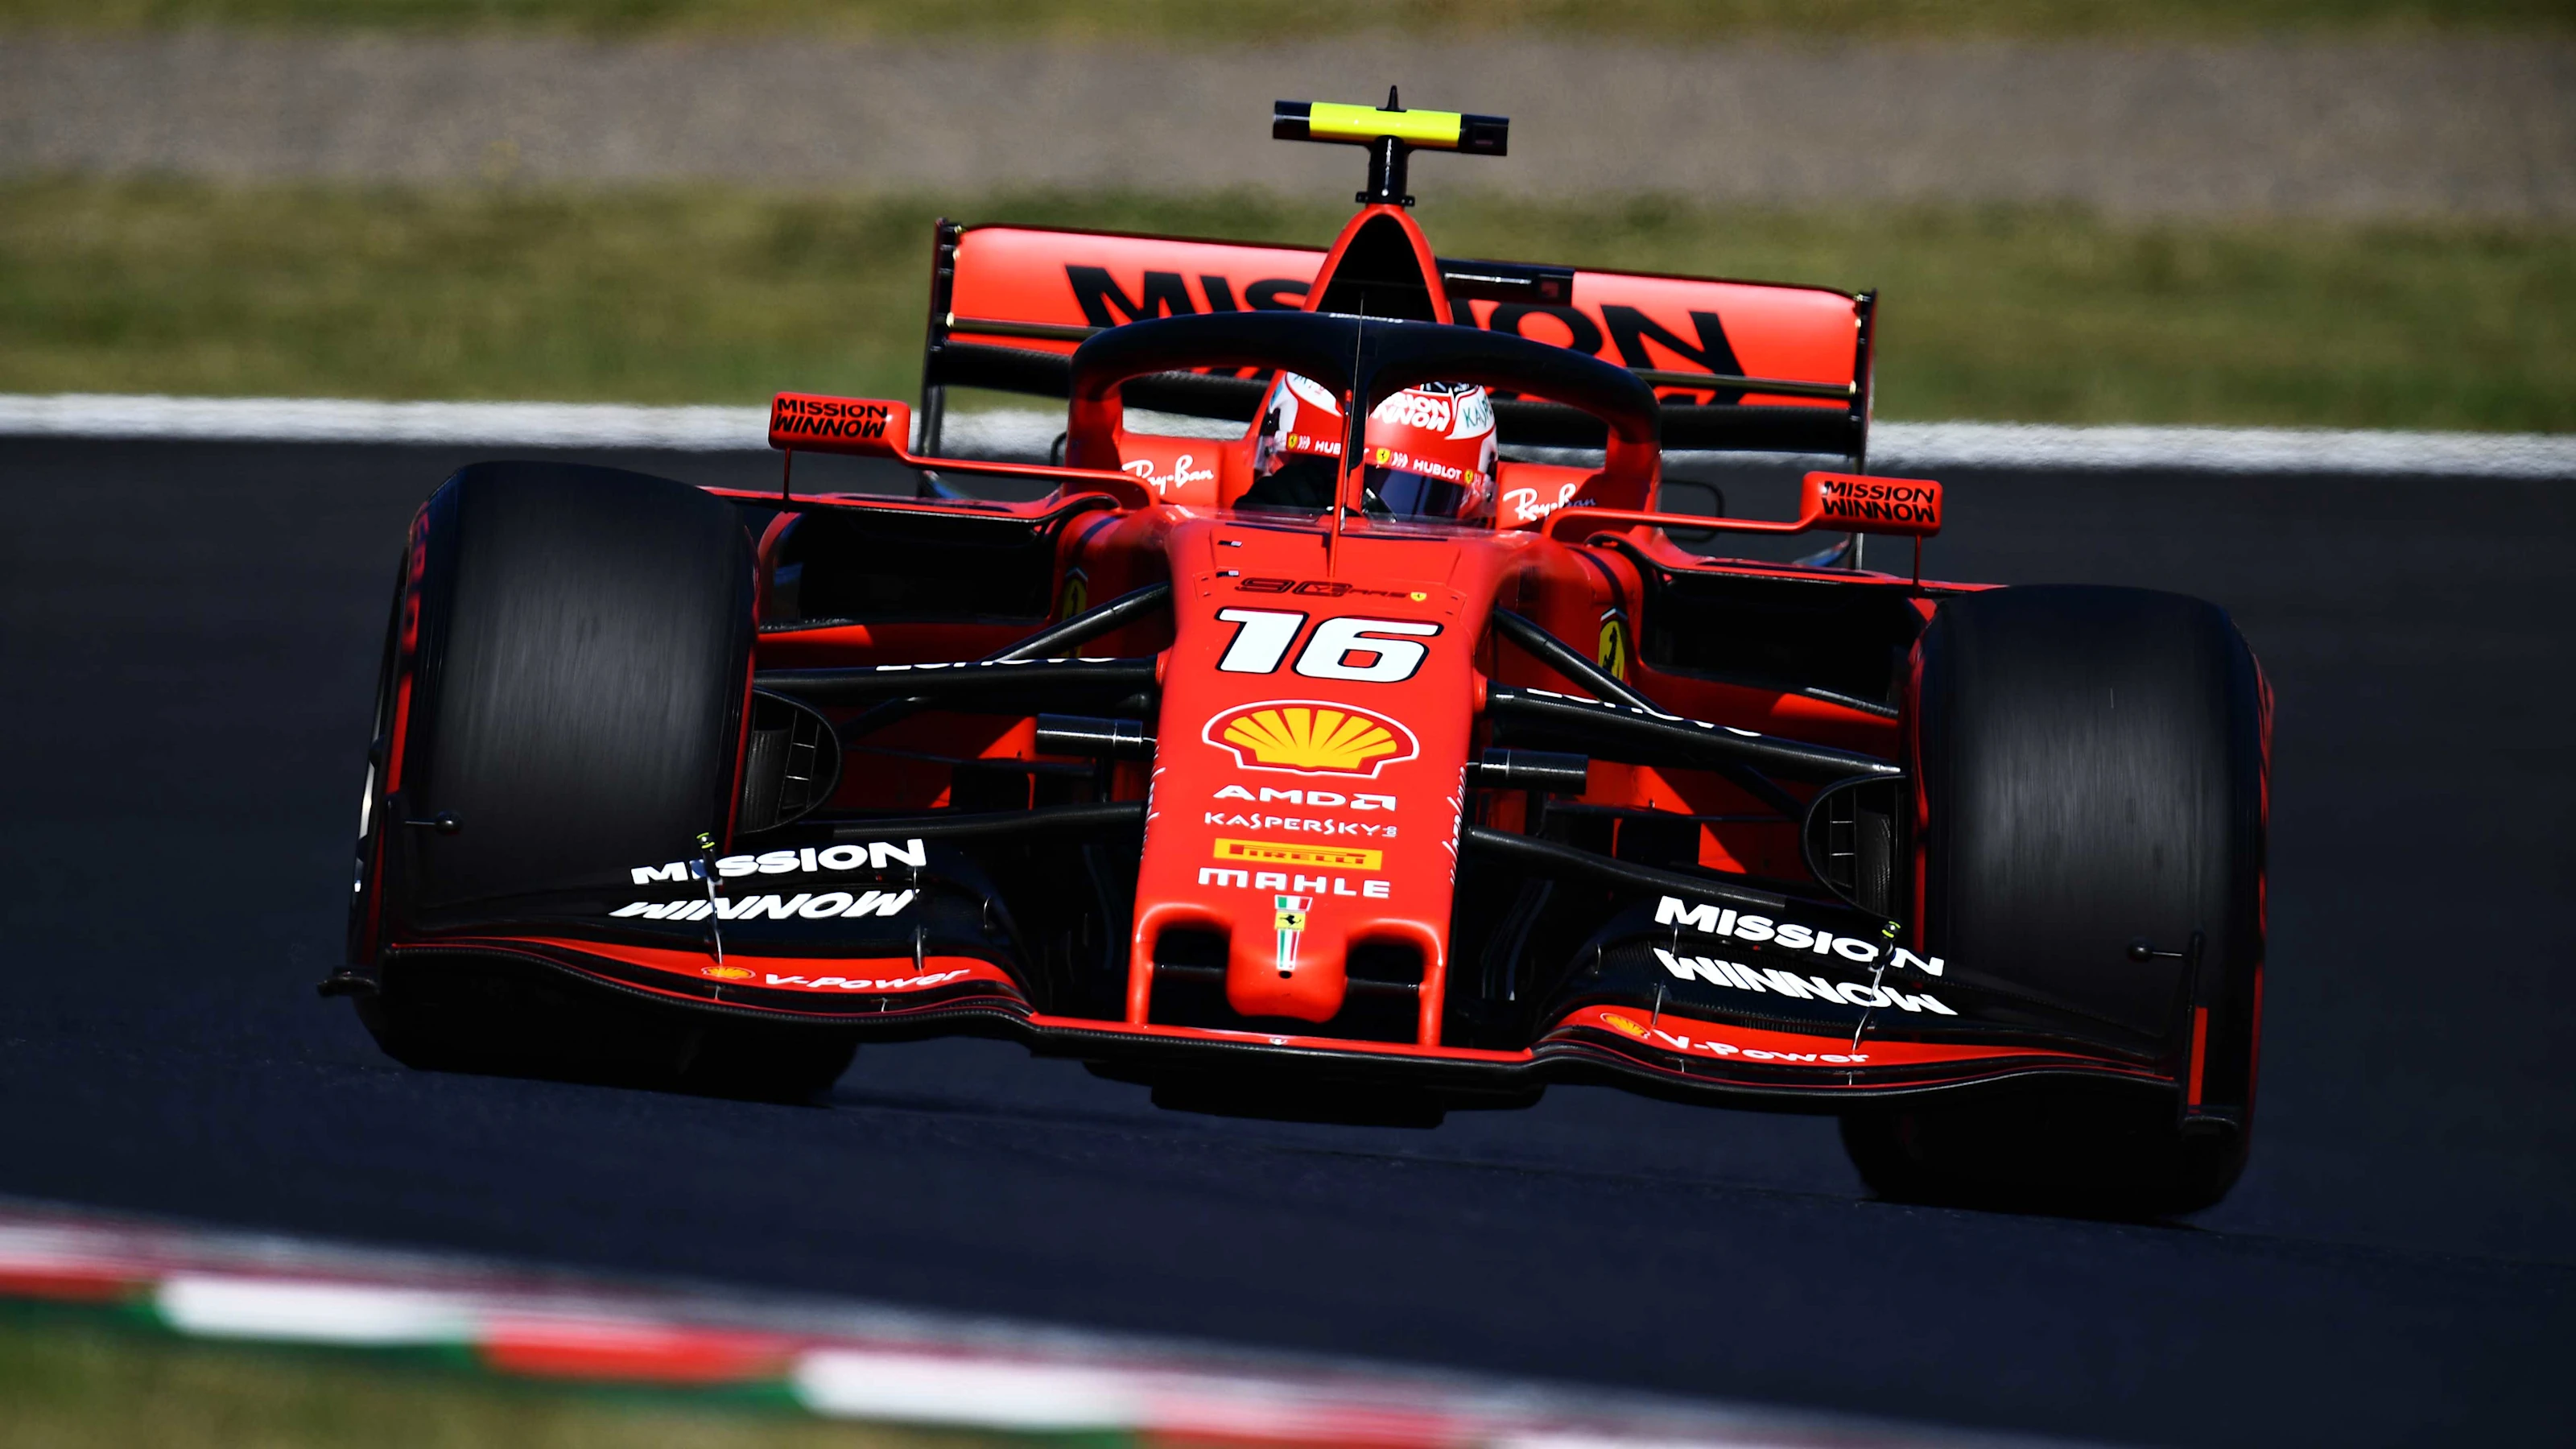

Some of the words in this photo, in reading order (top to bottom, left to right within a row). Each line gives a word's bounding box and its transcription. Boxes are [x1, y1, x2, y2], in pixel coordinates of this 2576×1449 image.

[777, 398, 888, 418] MISSION
[773, 413, 886, 439] WINNOW
[1121, 454, 1214, 496] Ray-Ban
[1413, 459, 1463, 481] HUBLOT
[1823, 481, 1934, 503] MISSION
[1822, 497, 1935, 522] WINNOW
[1213, 605, 1444, 683] 16
[1212, 784, 1347, 807] AMD
[1204, 811, 1381, 836] KASPERSKY
[1228, 843, 1368, 865] PIRELLI
[1197, 867, 1391, 898] MAHLE
[609, 889, 921, 922] WINNOW
[1654, 895, 1945, 977] MISSION
[765, 968, 971, 989] V-Power
[1653, 947, 1959, 1016] WINNOW
[1653, 1029, 1870, 1063] V-Power
